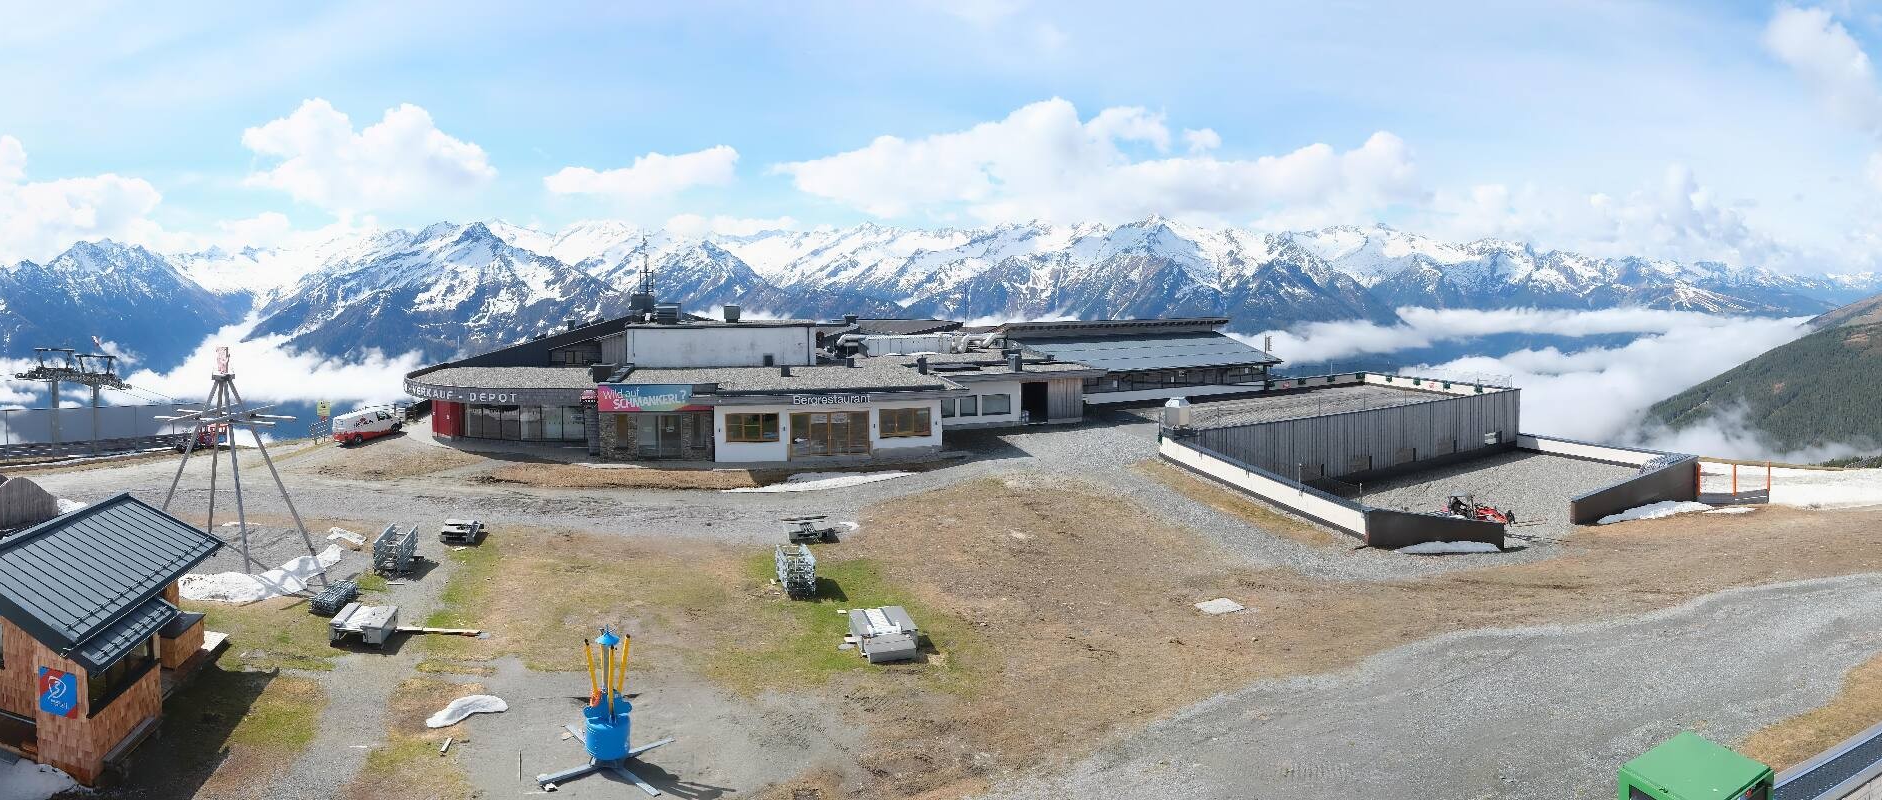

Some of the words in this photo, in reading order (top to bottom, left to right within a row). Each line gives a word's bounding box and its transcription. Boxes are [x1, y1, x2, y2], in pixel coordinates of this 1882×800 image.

[469, 392, 517, 403] DEPOT
[602, 388, 623, 400] Wild
[625, 386, 640, 397] auf
[613, 389, 686, 409] SCHMANKERL?
[793, 394, 871, 406] Bergrestaurant
